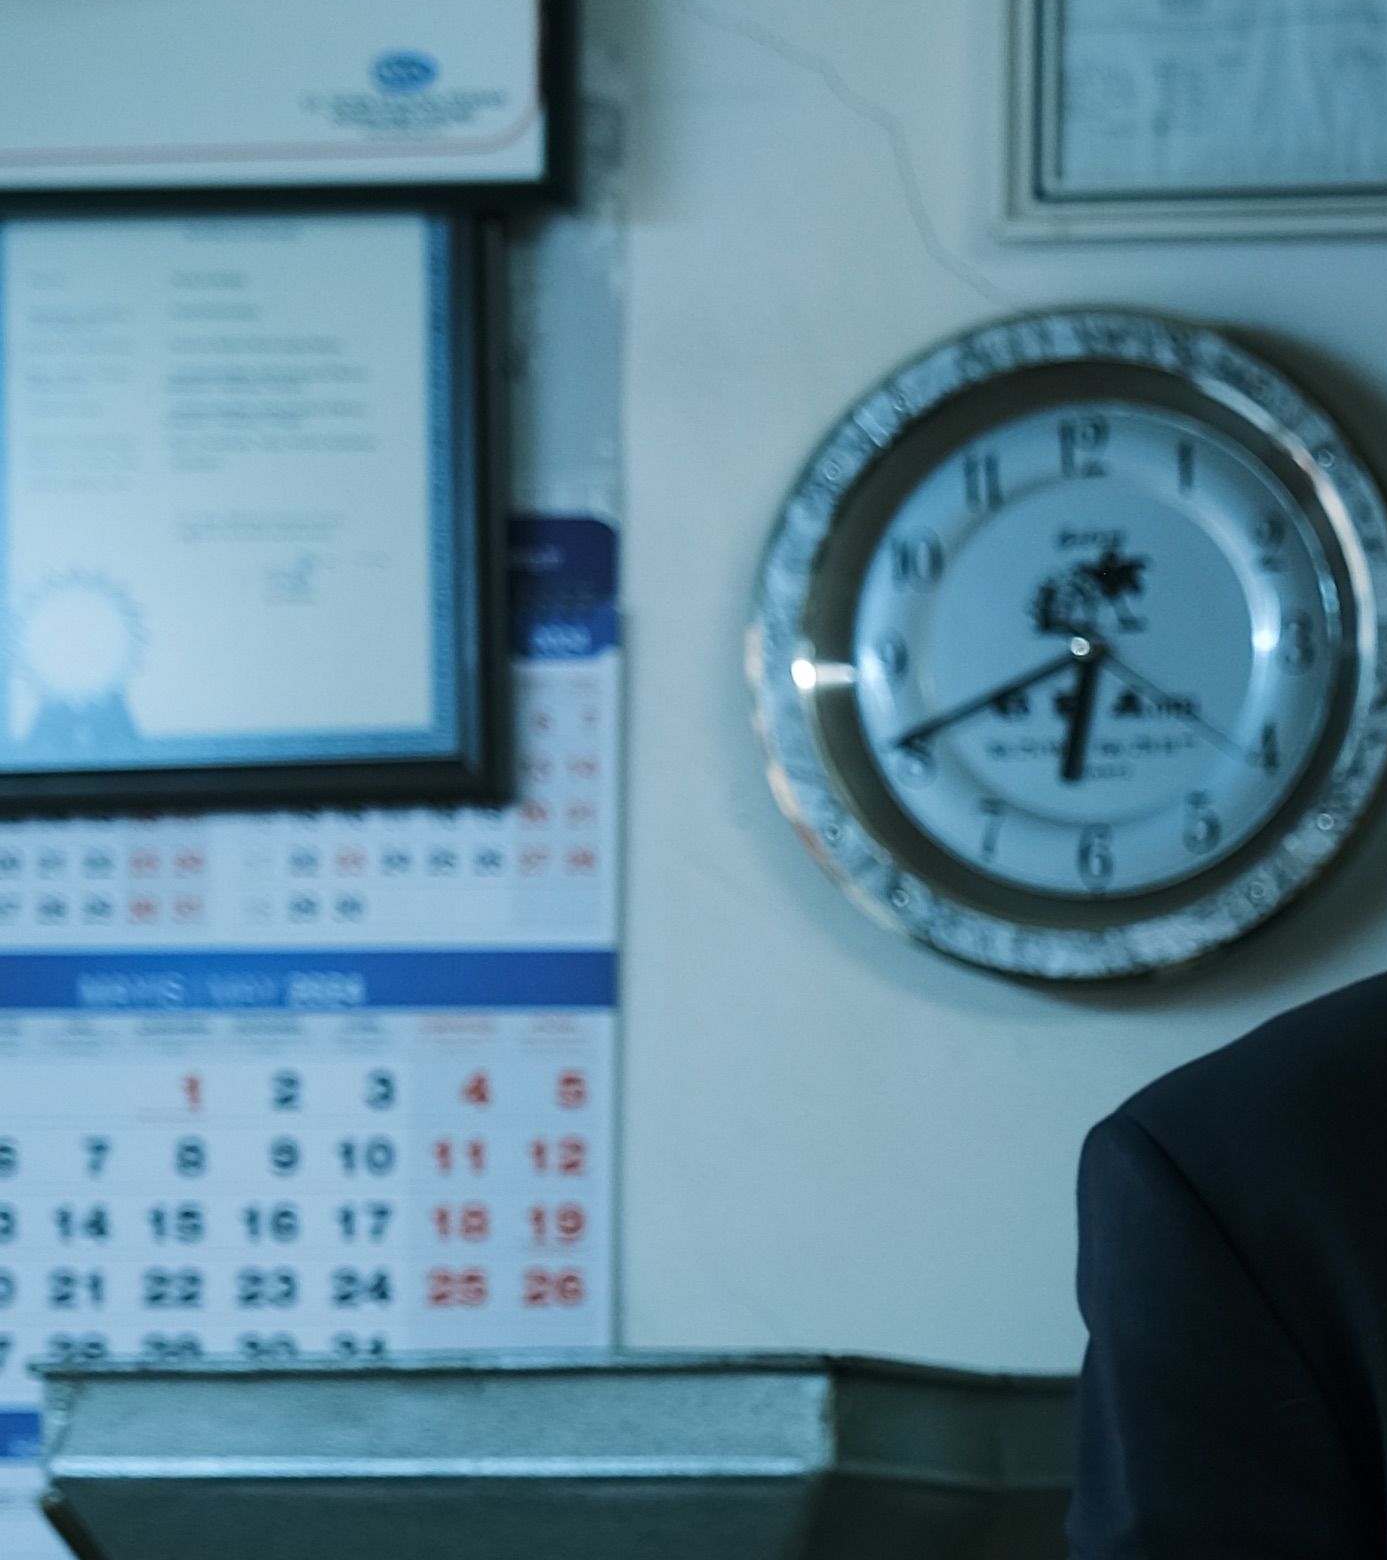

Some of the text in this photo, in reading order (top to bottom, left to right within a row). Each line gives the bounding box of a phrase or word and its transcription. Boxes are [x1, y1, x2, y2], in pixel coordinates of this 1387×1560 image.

[1058, 418, 1108, 478] 12
[1178, 443, 1193, 493] 1
[964, 453, 999, 512] 11
[898, 534, 942, 590] 10
[1183, 790, 1221, 852] 5
[1078, 824, 1114, 890] 6
[182, 1070, 586, 1111] 1 2 3 4 5
[82, 1136, 586, 1177] 7 8 9 10 11 12
[55, 1202, 585, 1242] 14 15 16 17 18 19
[49, 1267, 584, 1309] 21 22 23 24 25 26
